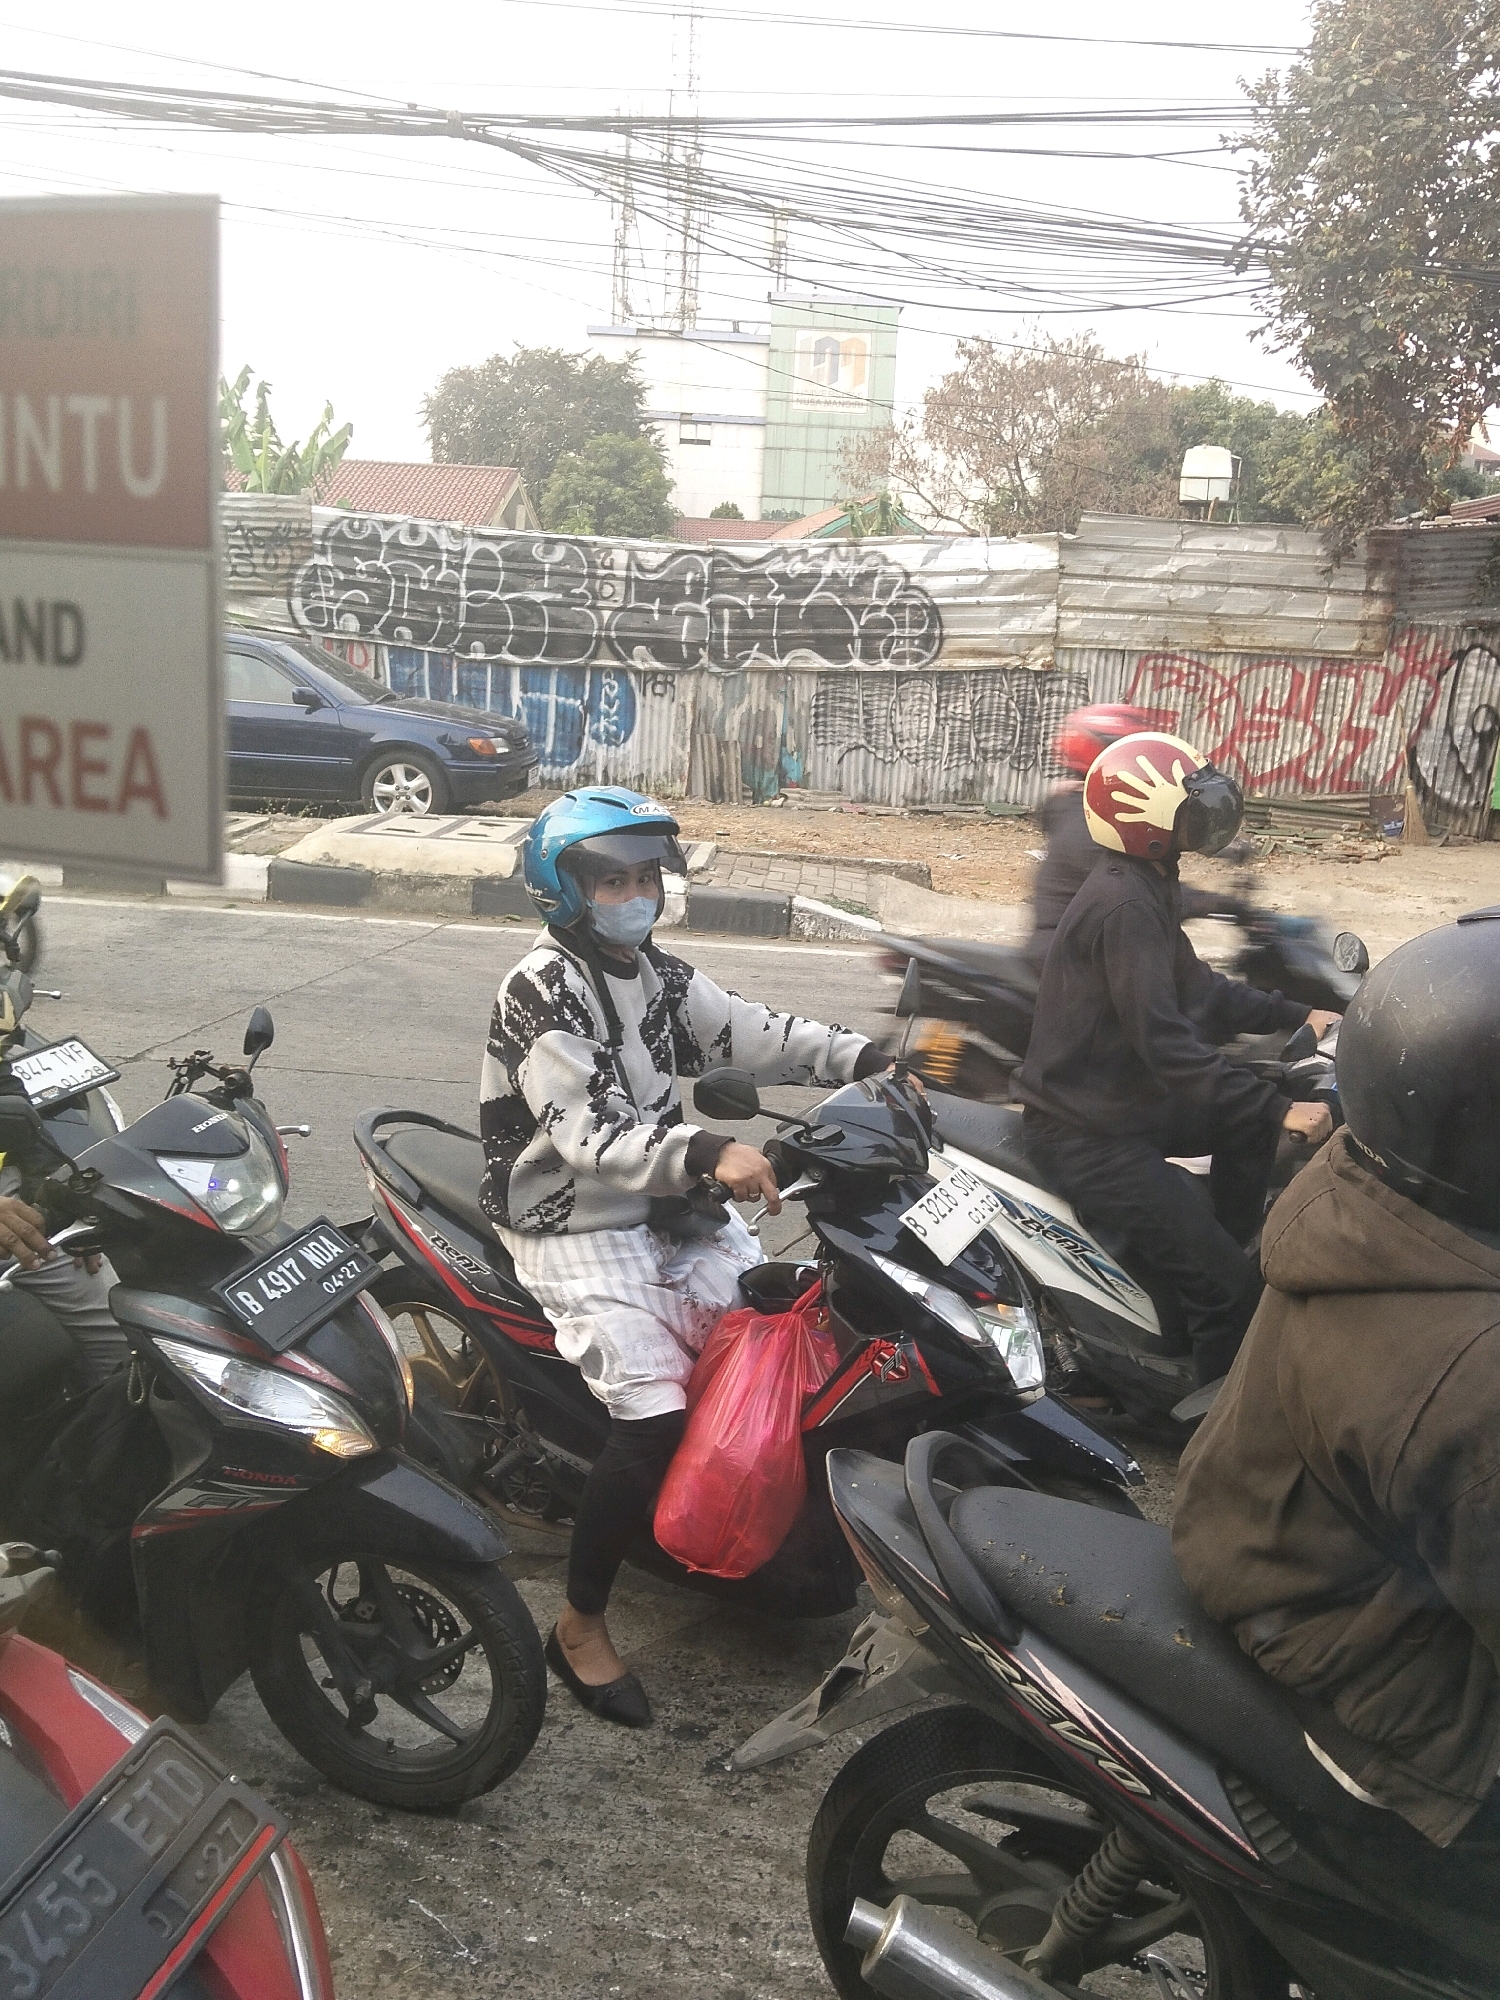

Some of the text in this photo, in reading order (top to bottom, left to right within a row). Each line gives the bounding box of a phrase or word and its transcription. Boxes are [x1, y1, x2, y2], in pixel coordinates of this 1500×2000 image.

[191, 1112, 229, 1134] HONDA
[905, 1216, 928, 1238] B
[918, 1187, 958, 1224] 3218
[236, 1235, 344, 1315] B 4917 NDA
[222, 1466, 298, 1485] HONDA
[960, 1631, 1151, 1796] REVO
[110, 1760, 204, 1856] ETD
